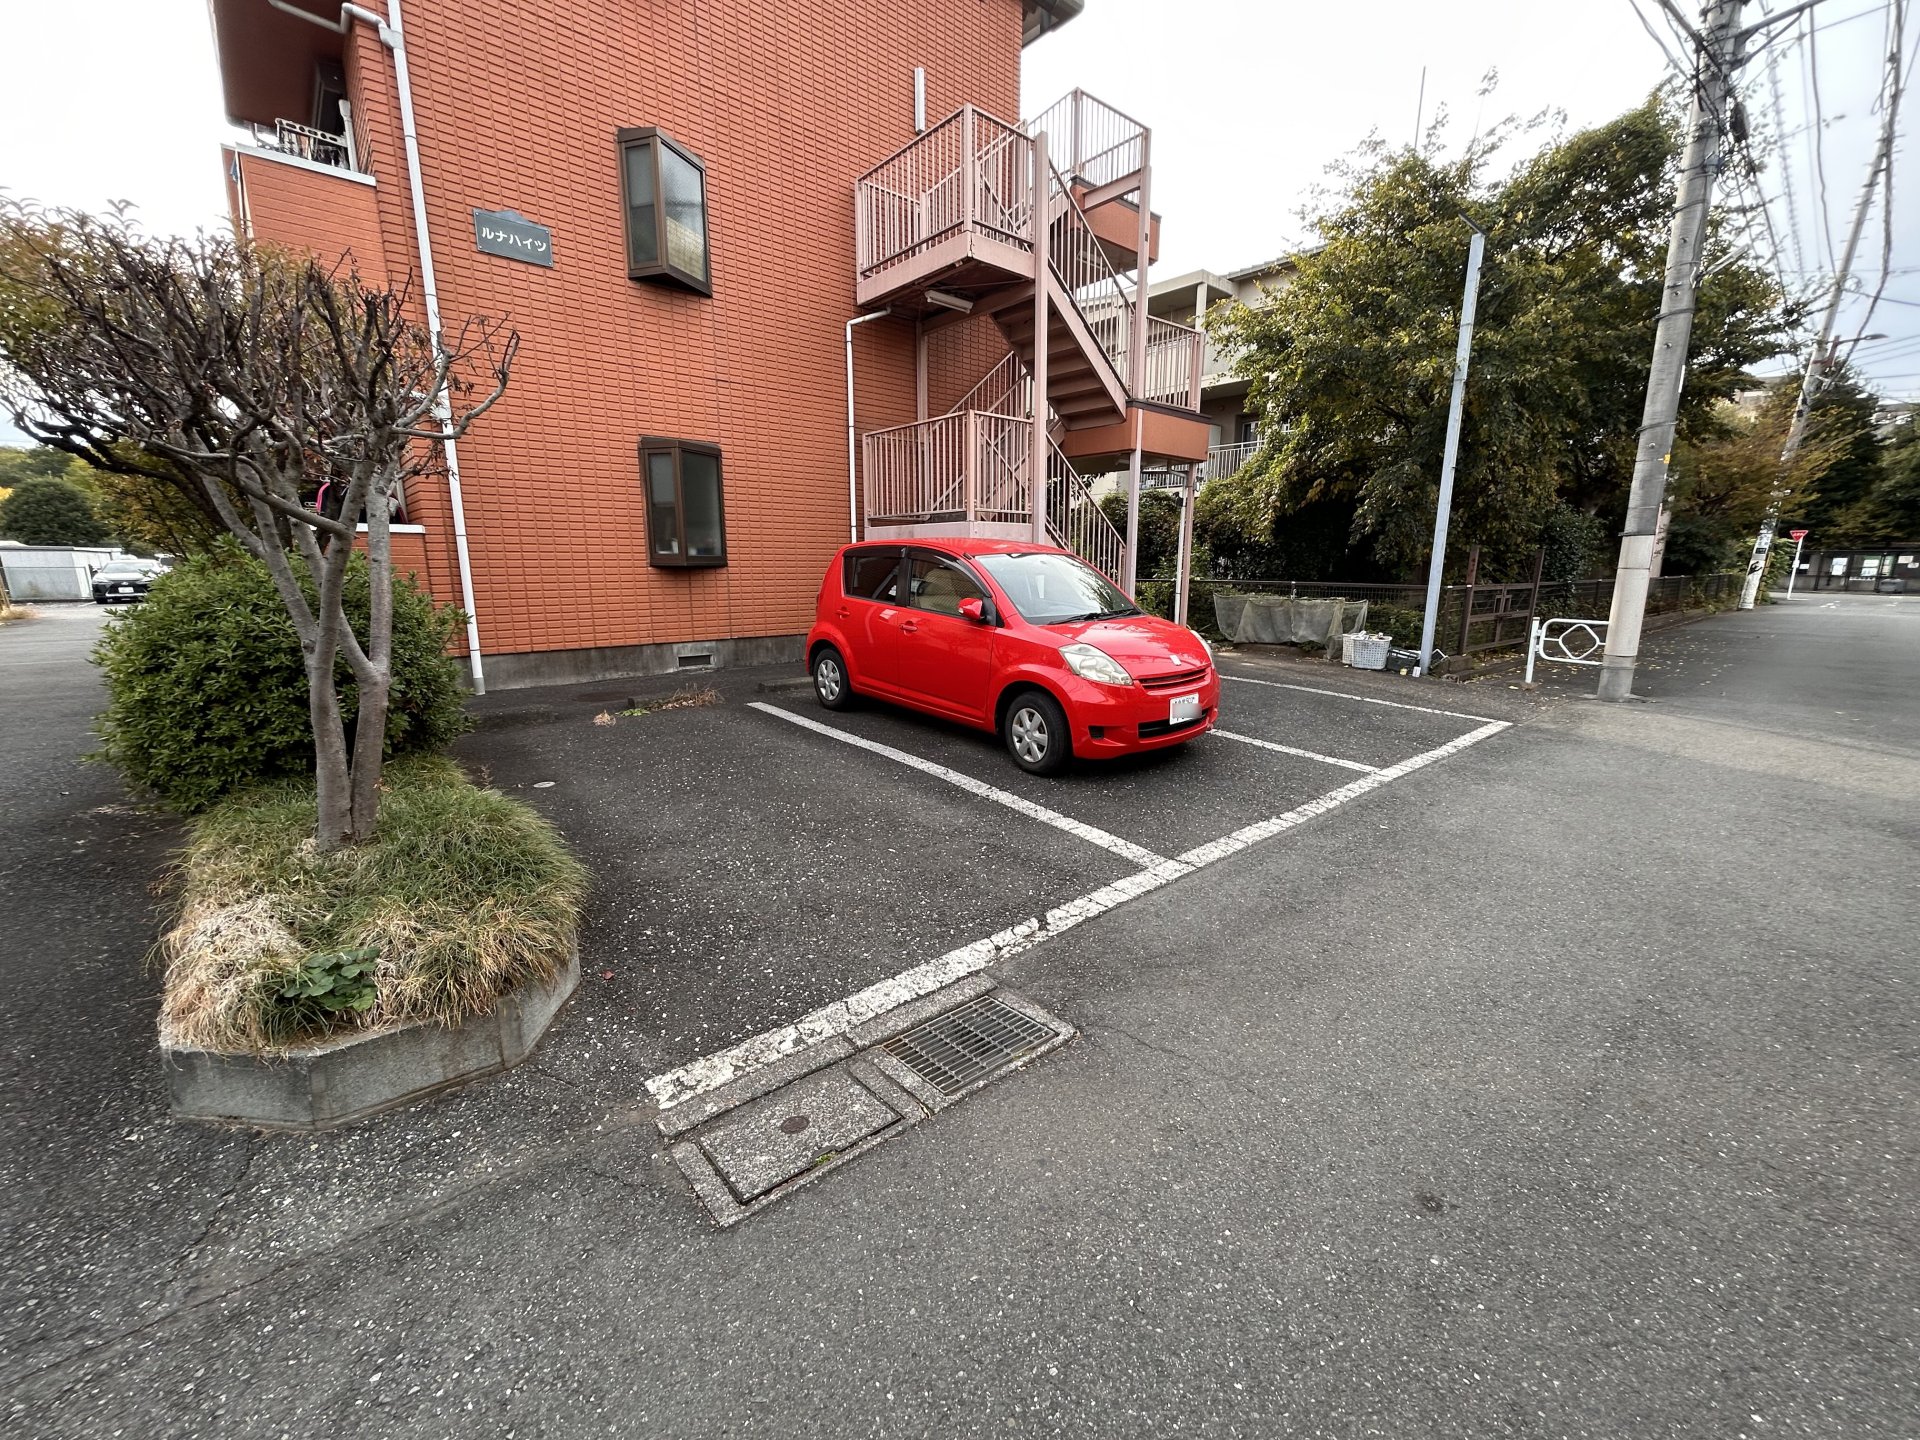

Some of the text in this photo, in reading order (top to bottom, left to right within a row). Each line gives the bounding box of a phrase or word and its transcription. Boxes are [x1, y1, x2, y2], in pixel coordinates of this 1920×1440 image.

[481, 227, 547, 252] ルナハイツ
